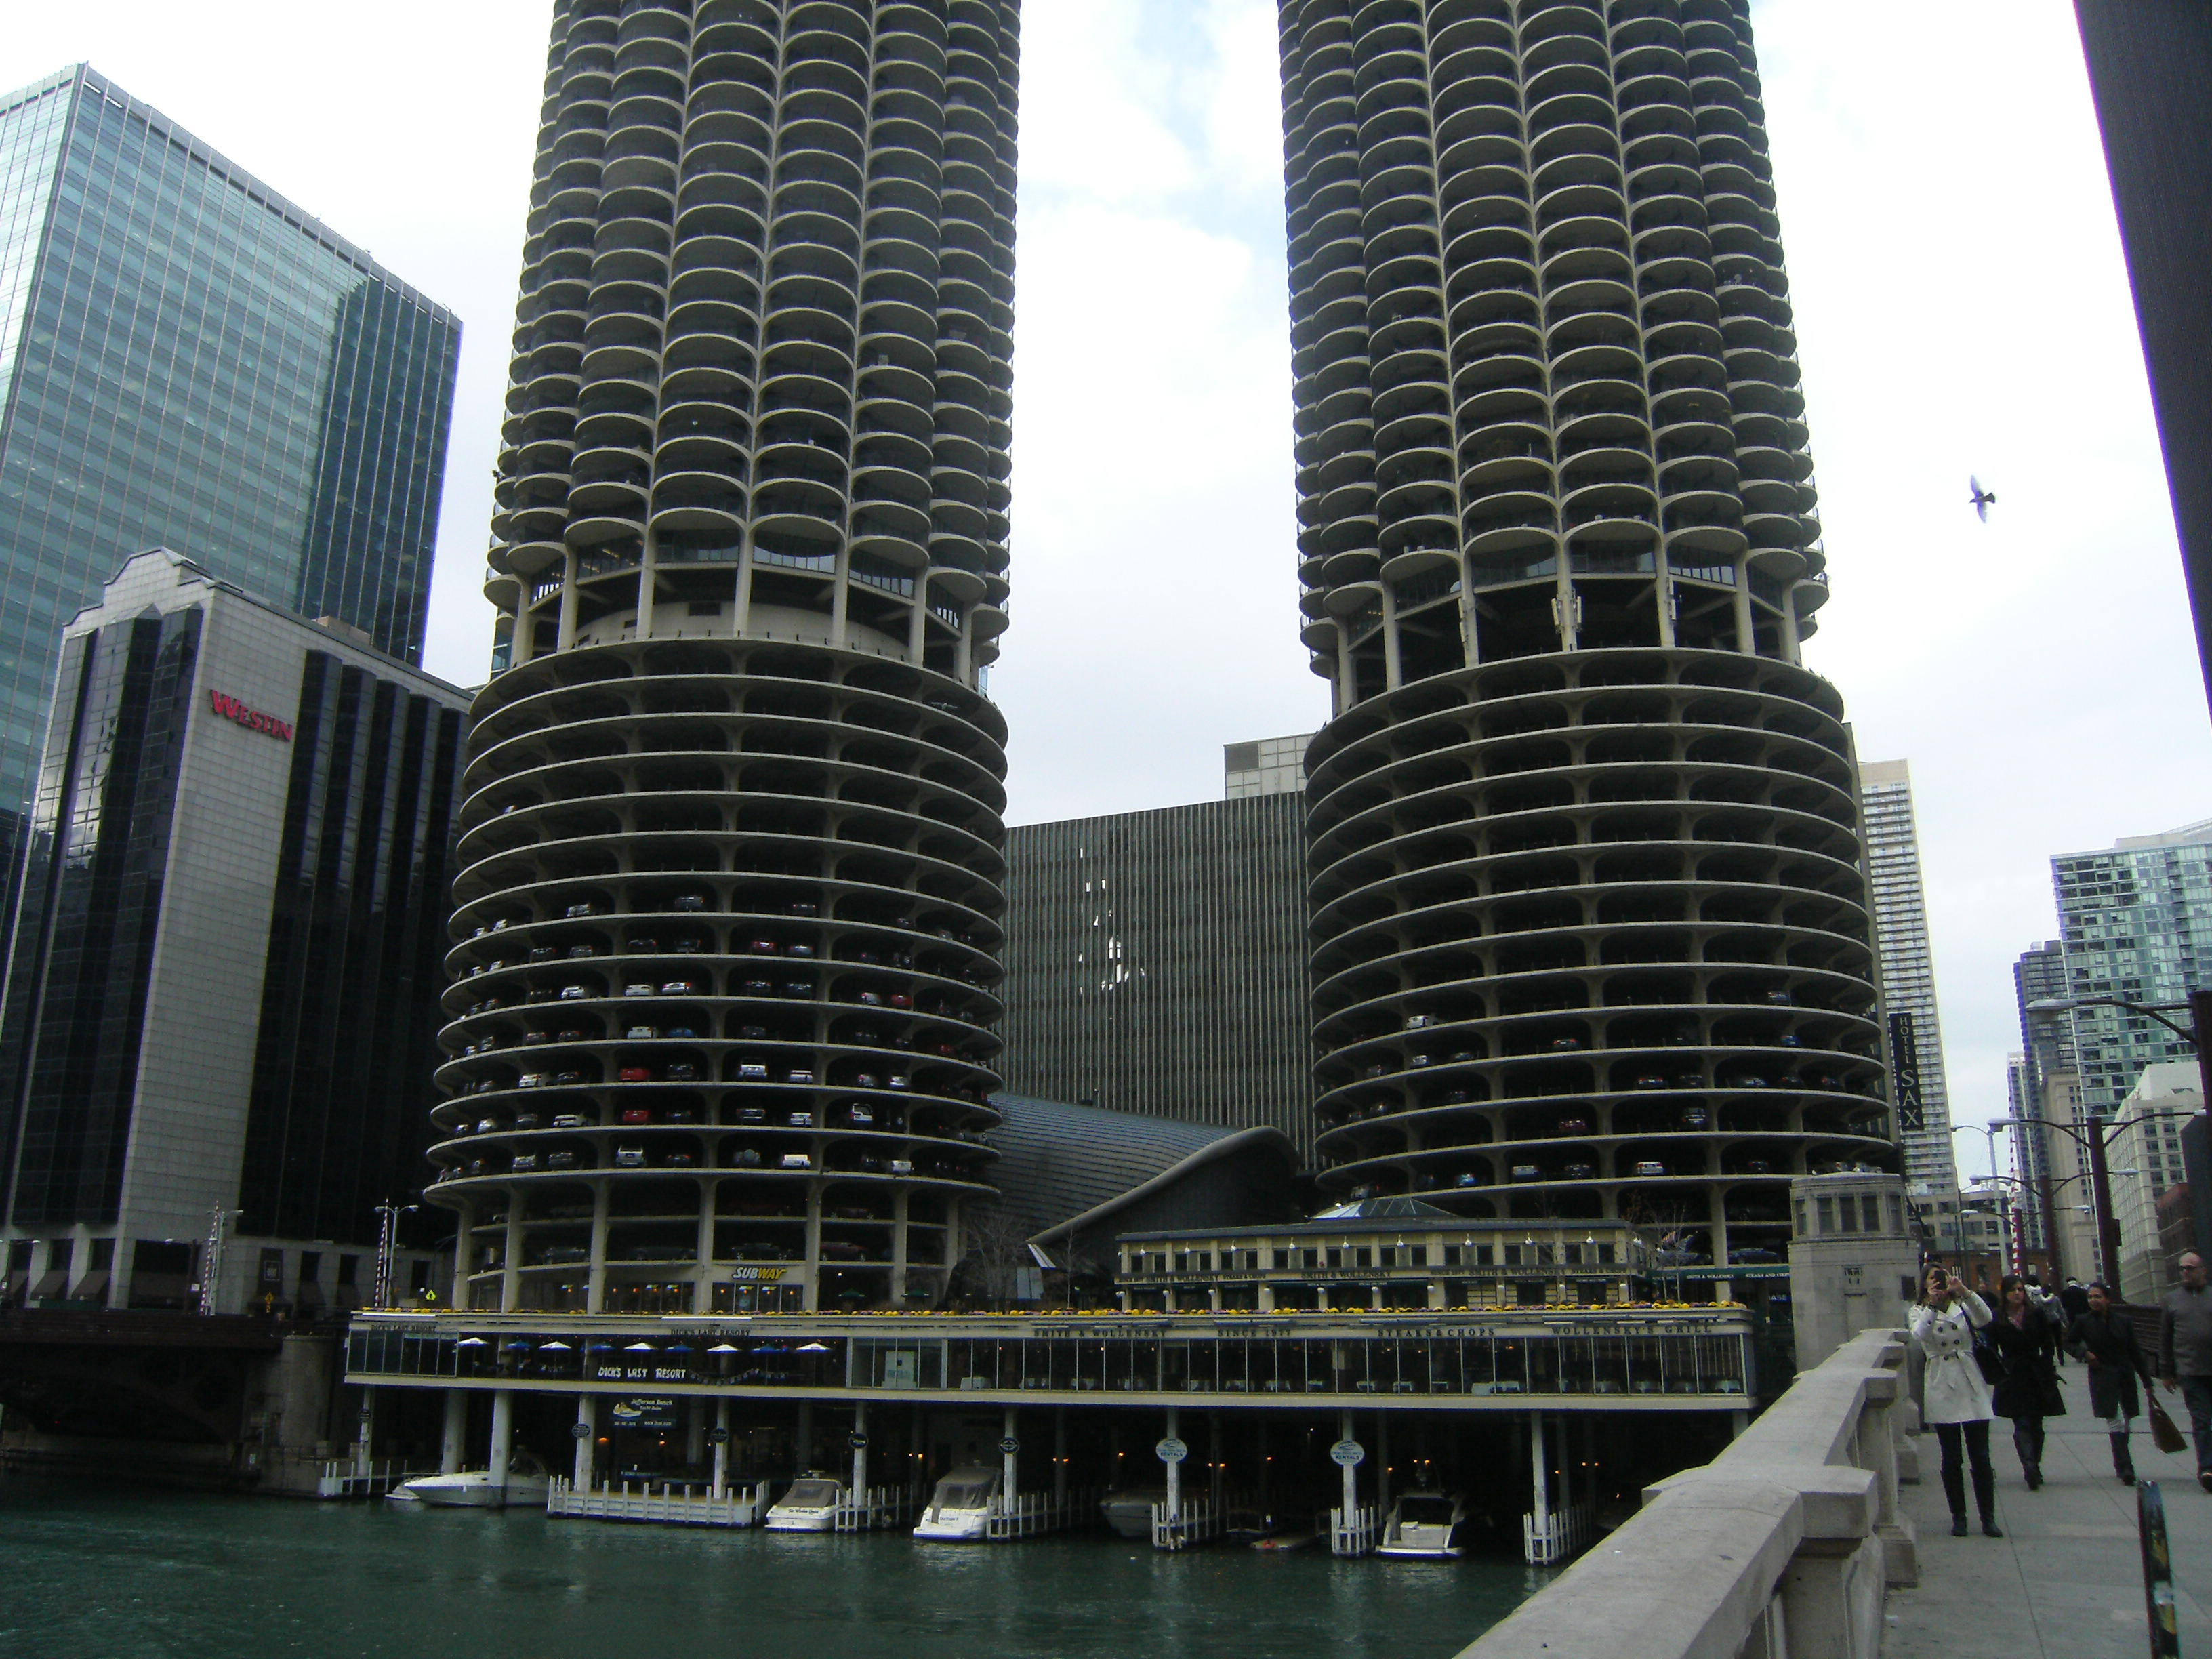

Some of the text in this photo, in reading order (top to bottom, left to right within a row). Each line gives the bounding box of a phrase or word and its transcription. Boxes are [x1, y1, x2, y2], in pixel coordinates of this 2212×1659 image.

[211, 690, 293, 741] WESTIN
[1900, 1017, 1920, 1126] HOTEL SAX
[733, 1267, 787, 1279] SUBWAY
[1301, 1270, 1328, 1279] SMITH
[1340, 1269, 1391, 1279] WOLLENSKY
[1033, 1328, 1071, 1337] SMITH
[1092, 1328, 1166, 1338] WOLLENSKY
[1552, 1326, 1654, 1334] WOLLENSKY'S
[1665, 1325, 1712, 1334] GRILL
[598, 1367, 686, 1379] DICK'S LAST RESORT
